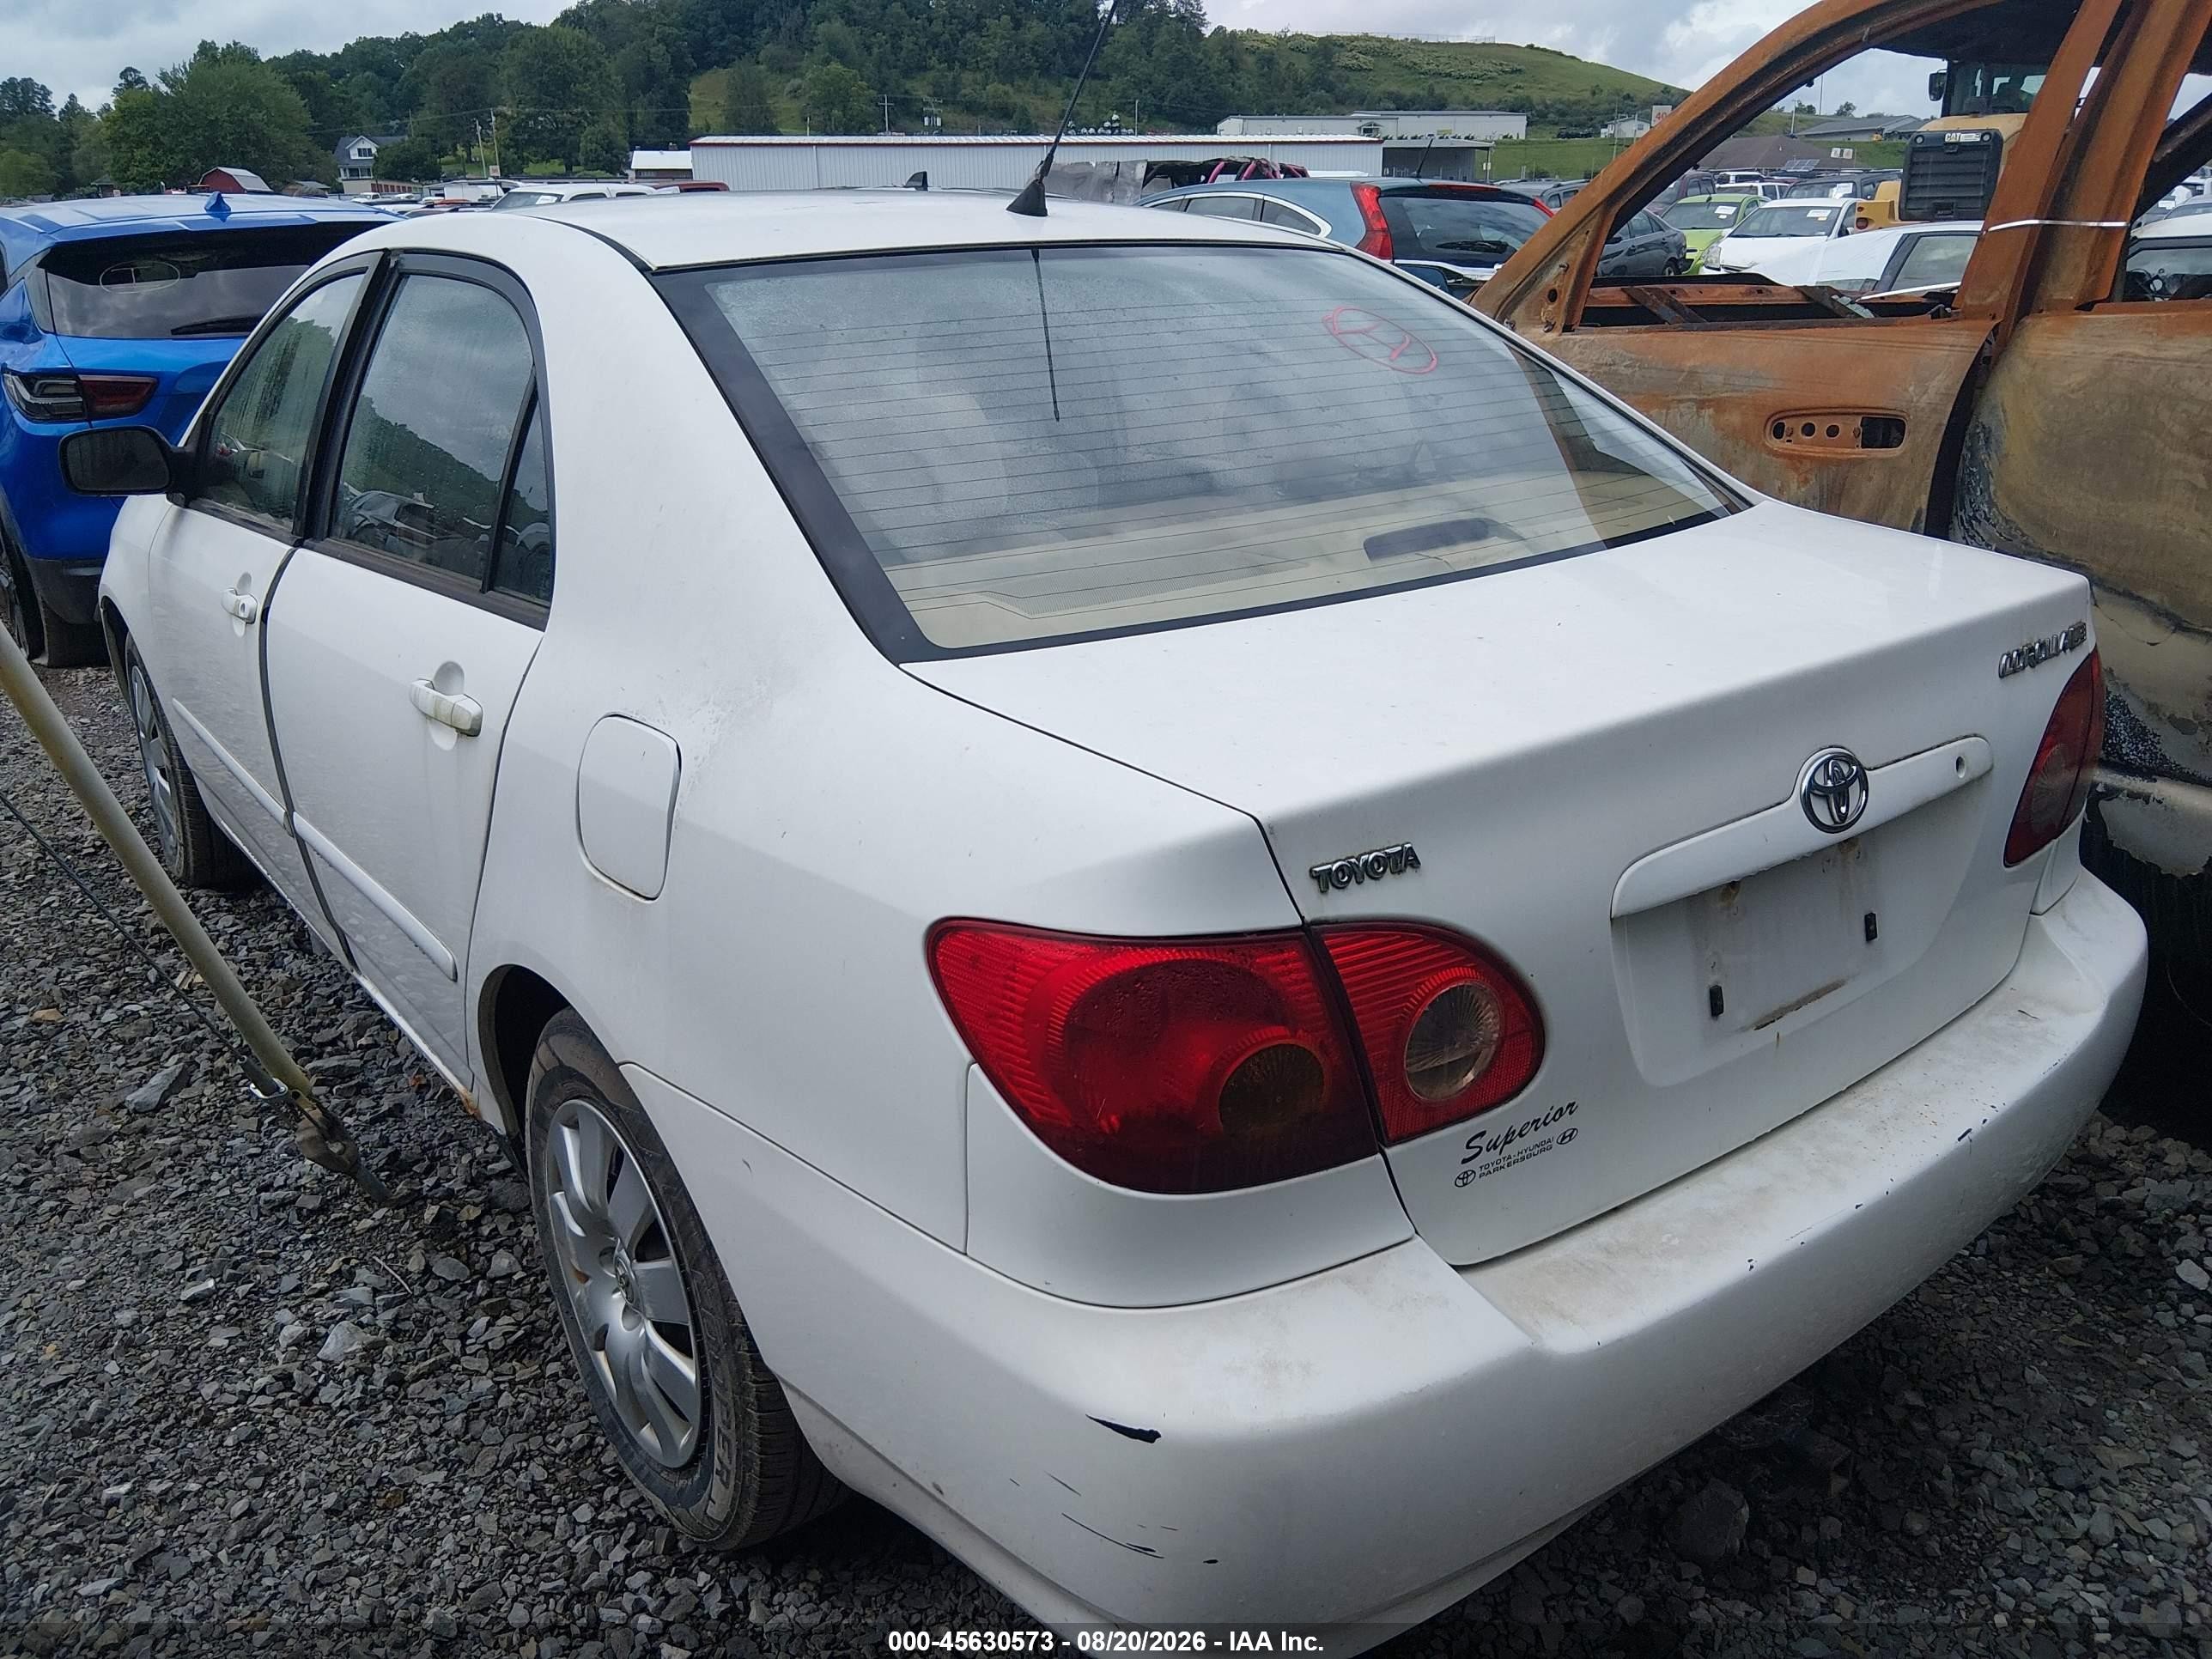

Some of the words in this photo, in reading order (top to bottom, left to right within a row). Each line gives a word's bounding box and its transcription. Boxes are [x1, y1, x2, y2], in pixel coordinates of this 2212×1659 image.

[1945, 133, 1961, 143] CAT
[1310, 842, 1421, 893] TOYOTA
[1461, 1101, 1578, 1165] Superior
[1479, 1144, 1553, 1179] PARKERSBURG
